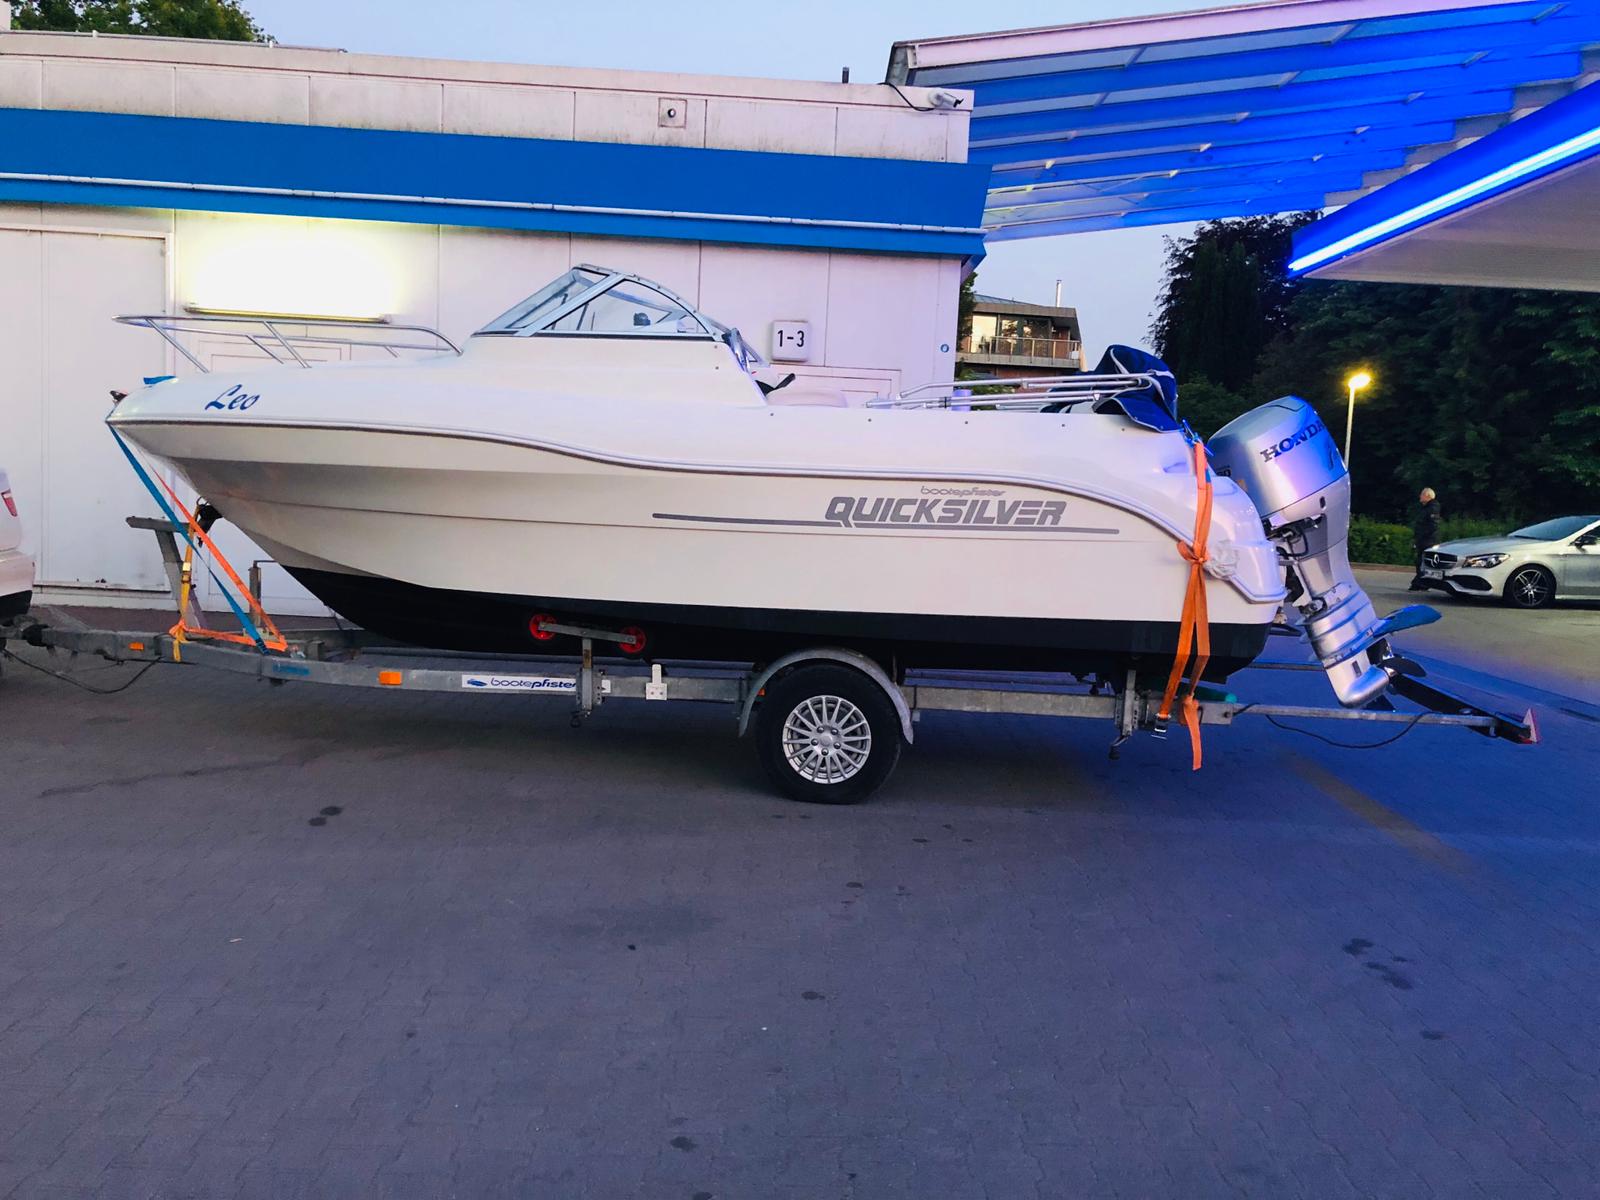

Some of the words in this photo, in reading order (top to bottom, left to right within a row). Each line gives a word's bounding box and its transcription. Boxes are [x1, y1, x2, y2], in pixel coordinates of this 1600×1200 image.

[777, 329, 805, 348] 1-3
[204, 384, 260, 411] Leo
[825, 496, 1067, 528] QUICKSILVER
